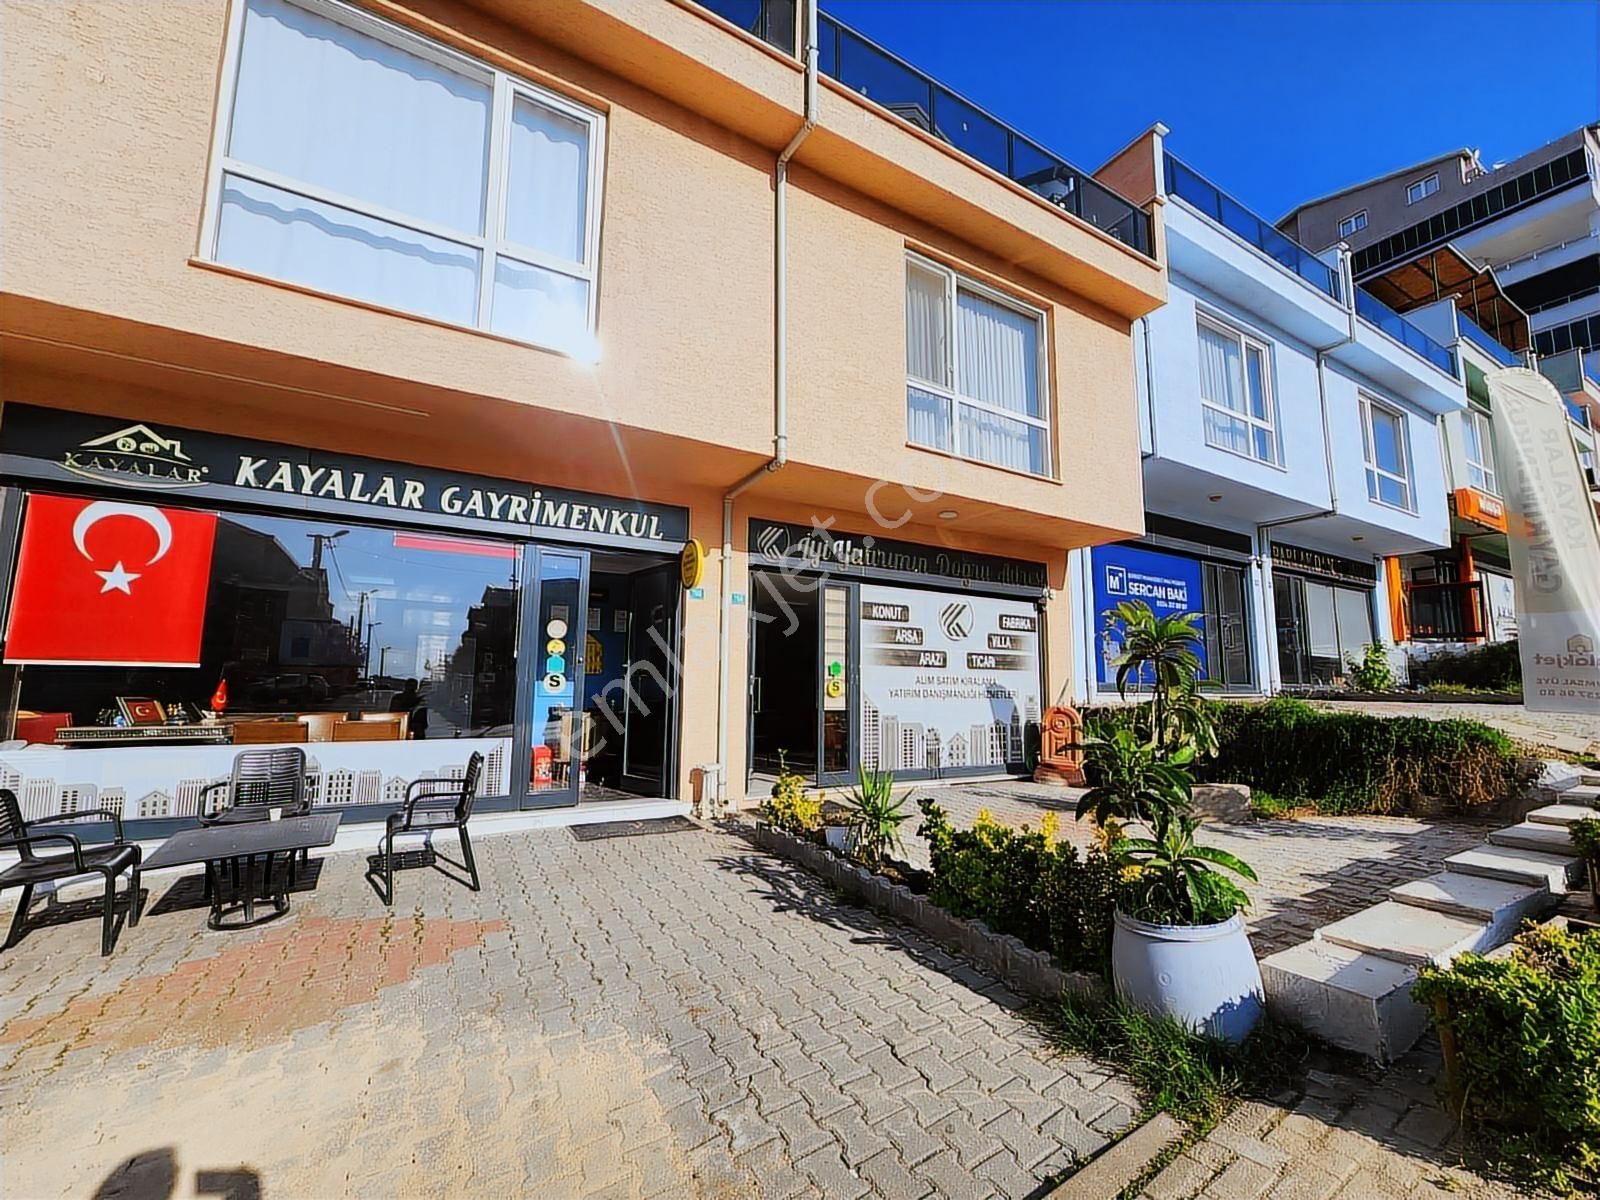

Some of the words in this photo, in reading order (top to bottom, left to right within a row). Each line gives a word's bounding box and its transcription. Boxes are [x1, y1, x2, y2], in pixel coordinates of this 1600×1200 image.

[65, 452, 201, 482] KAYALAR
[235, 456, 425, 510] KAYALAR
[439, 486, 665, 540] GAYRİMENKUL
[1128, 581, 1166, 600] SERCAN
[872, 604, 904, 621] KONUT
[895, 629, 920, 644] ARSA
[549, 675, 561, 688] S
[832, 681, 840, 692] S
[915, 675, 935, 685] ALIM
[936, 675, 959, 686] SATIM
